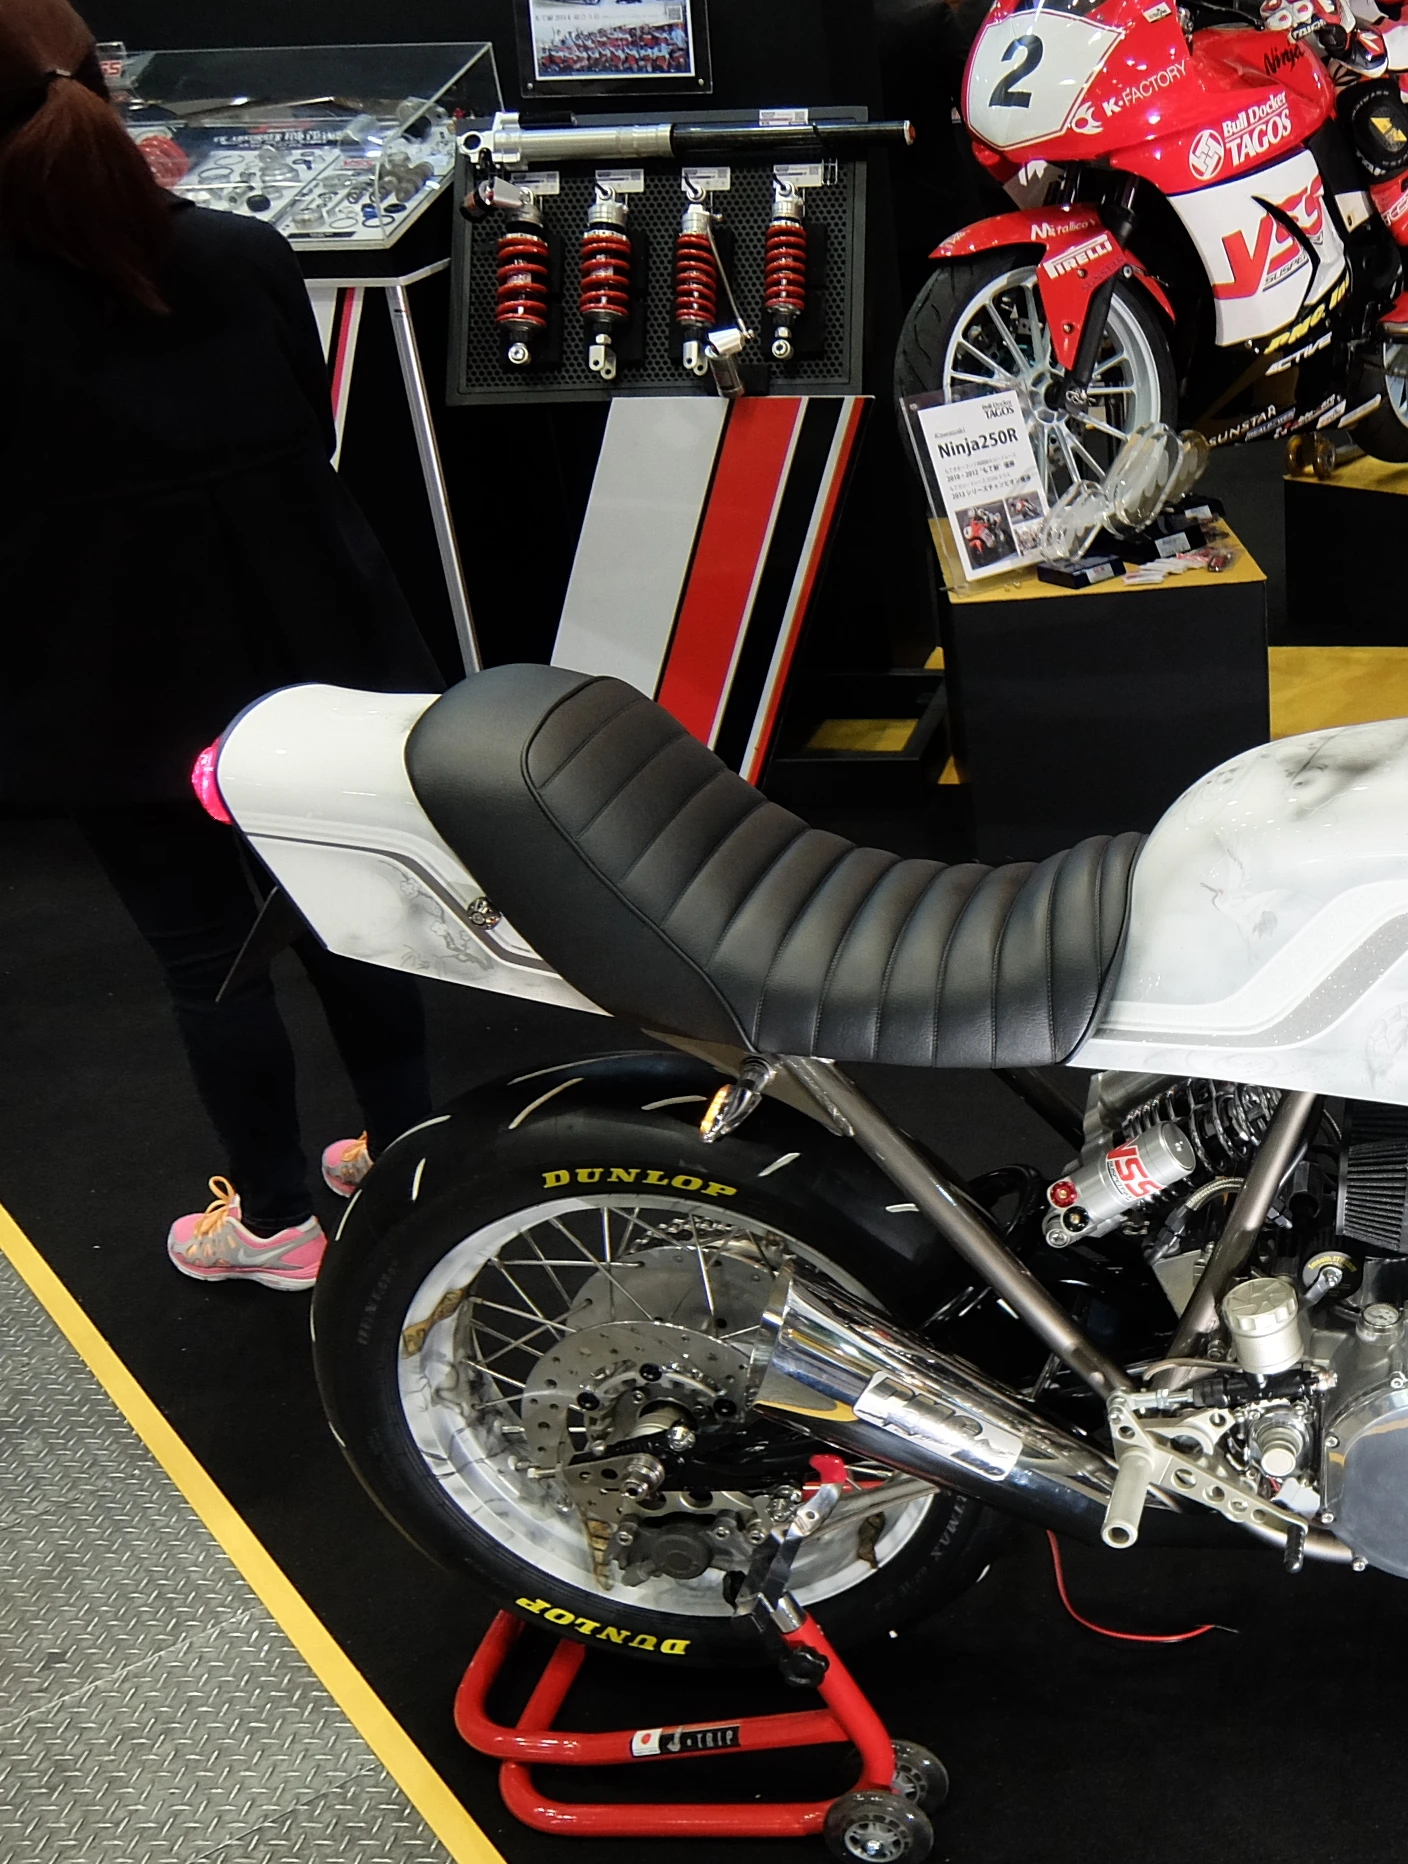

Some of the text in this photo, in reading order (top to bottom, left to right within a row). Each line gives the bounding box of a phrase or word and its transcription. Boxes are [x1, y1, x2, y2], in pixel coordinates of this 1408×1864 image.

[101, 61, 122, 76] SS
[989, 34, 1043, 108] 2
[1263, 43, 1305, 75] Ninja
[1222, 91, 1287, 137] Bull Docker
[1226, 108, 1292, 167] TAGOS
[1043, 233, 1113, 280] PIRELLI
[1265, 331, 1333, 376] ACTIVE
[985, 406, 1015, 420] TAGOS
[1209, 404, 1278, 447] SUNSTAR
[937, 427, 1019, 459] Ninja250R
[541, 1166, 739, 1200] DUNLOP
[1107, 1138, 1166, 1198] YSS
[514, 1596, 693, 1656] DUNLOP
